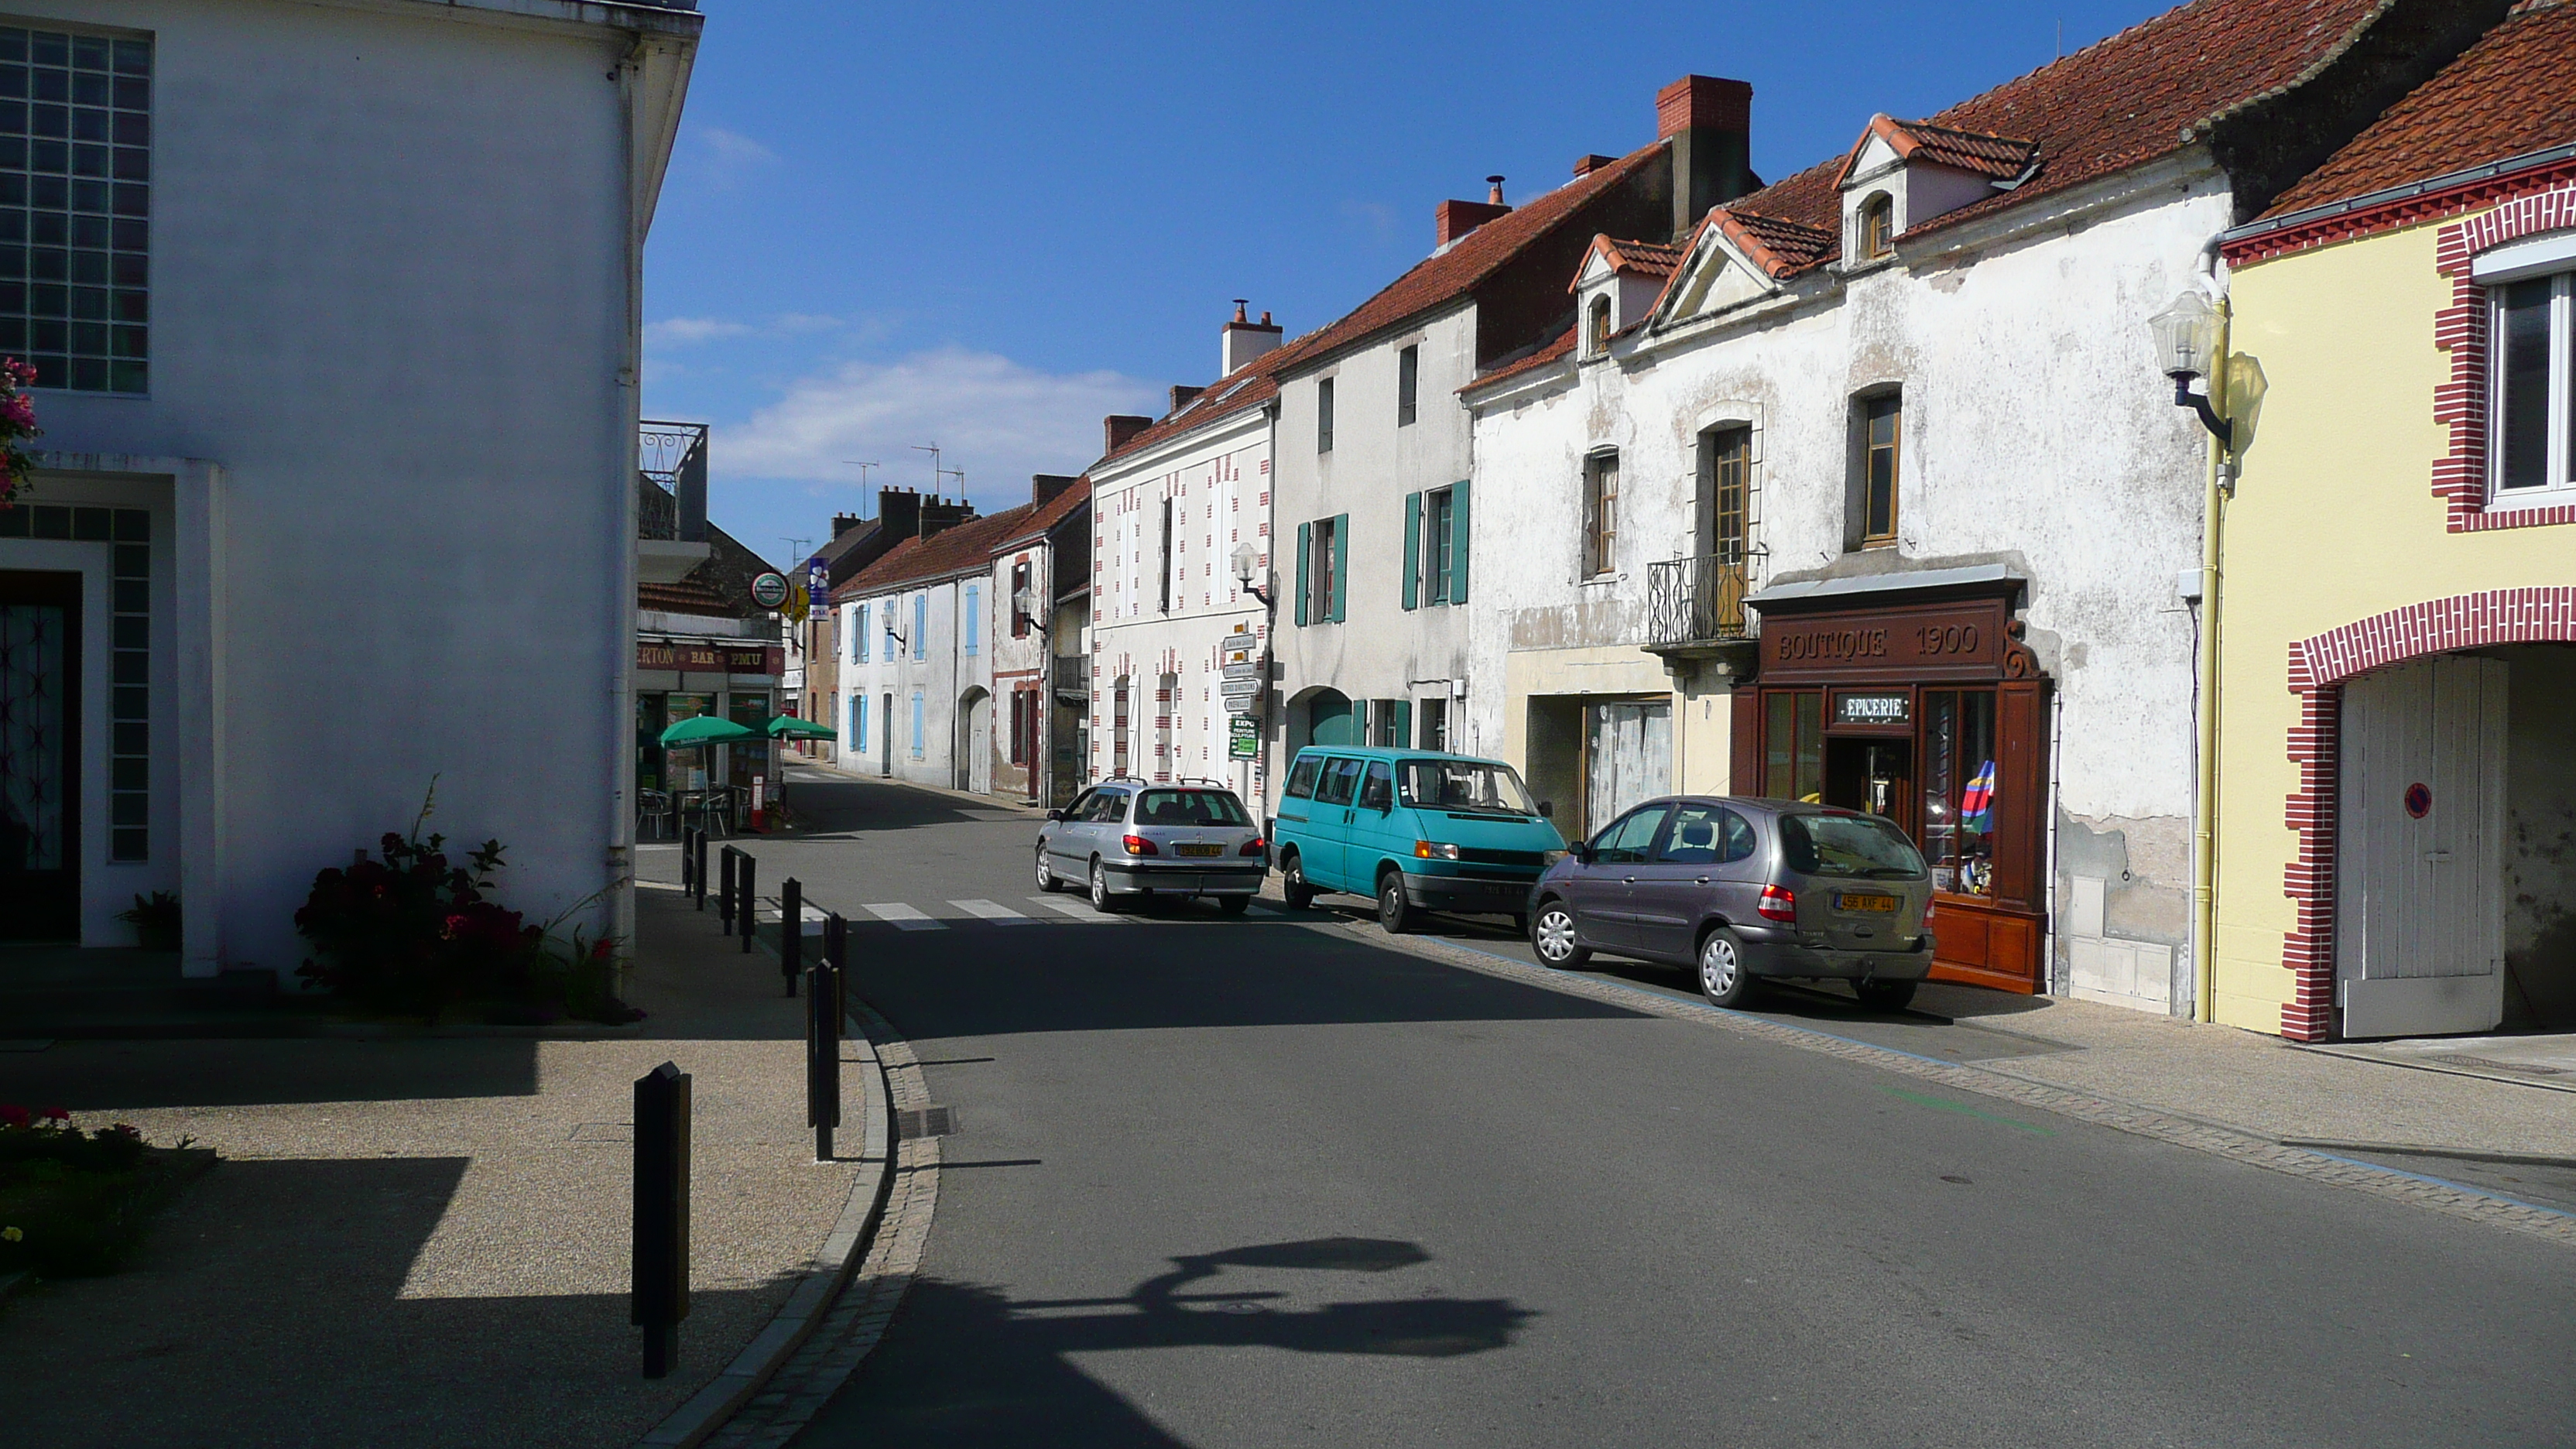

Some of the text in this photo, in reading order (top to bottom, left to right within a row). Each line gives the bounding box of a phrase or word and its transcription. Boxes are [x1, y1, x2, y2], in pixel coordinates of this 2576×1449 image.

[1780, 623, 1978, 662] BOUTIQUE 1900
[690, 651, 714, 664] BAR
[730, 653, 762, 665] PMU
[1235, 682, 1255, 691] DIRECTIONS
[1846, 698, 1903, 718] EPICERIE
[1842, 895, 1893, 909] 456 AXF 44
